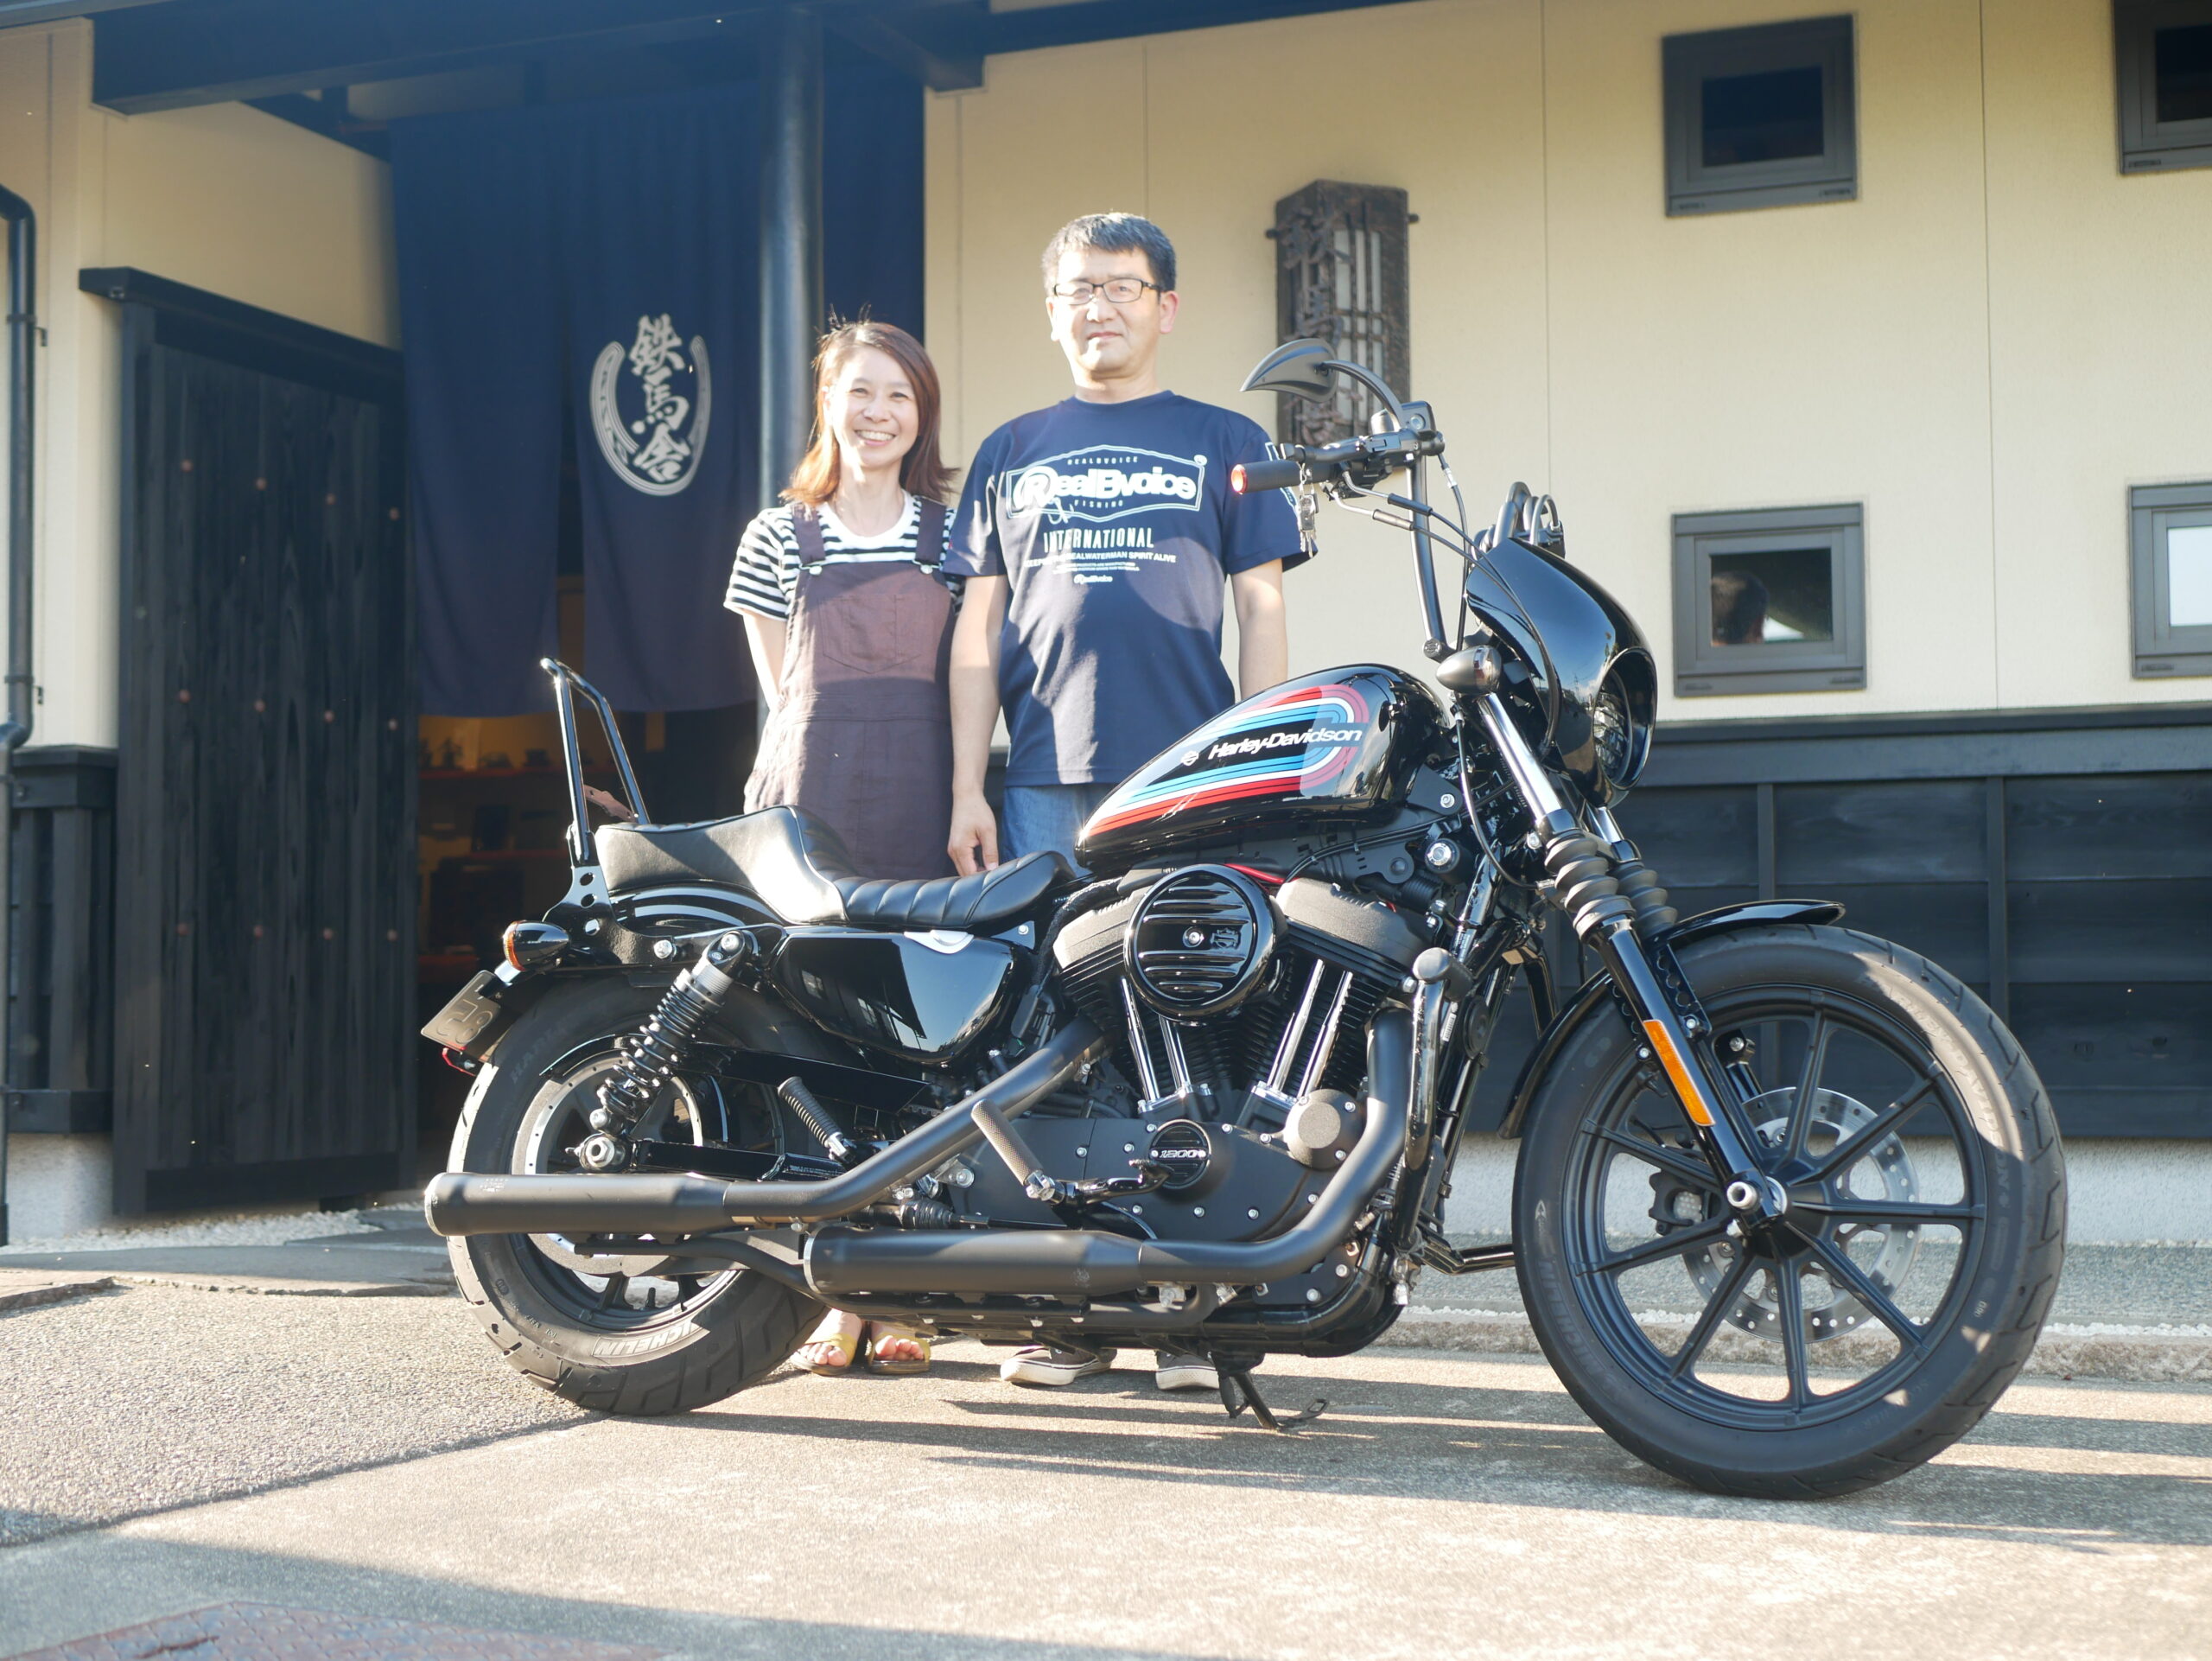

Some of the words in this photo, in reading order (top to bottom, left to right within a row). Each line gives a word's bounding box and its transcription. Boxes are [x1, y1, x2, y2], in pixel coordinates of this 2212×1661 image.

[1044, 528, 1154, 553] INTERNATIONAL
[1208, 727, 1363, 760] Harley-Davidson
[1160, 1149, 1198, 1159] 1200
